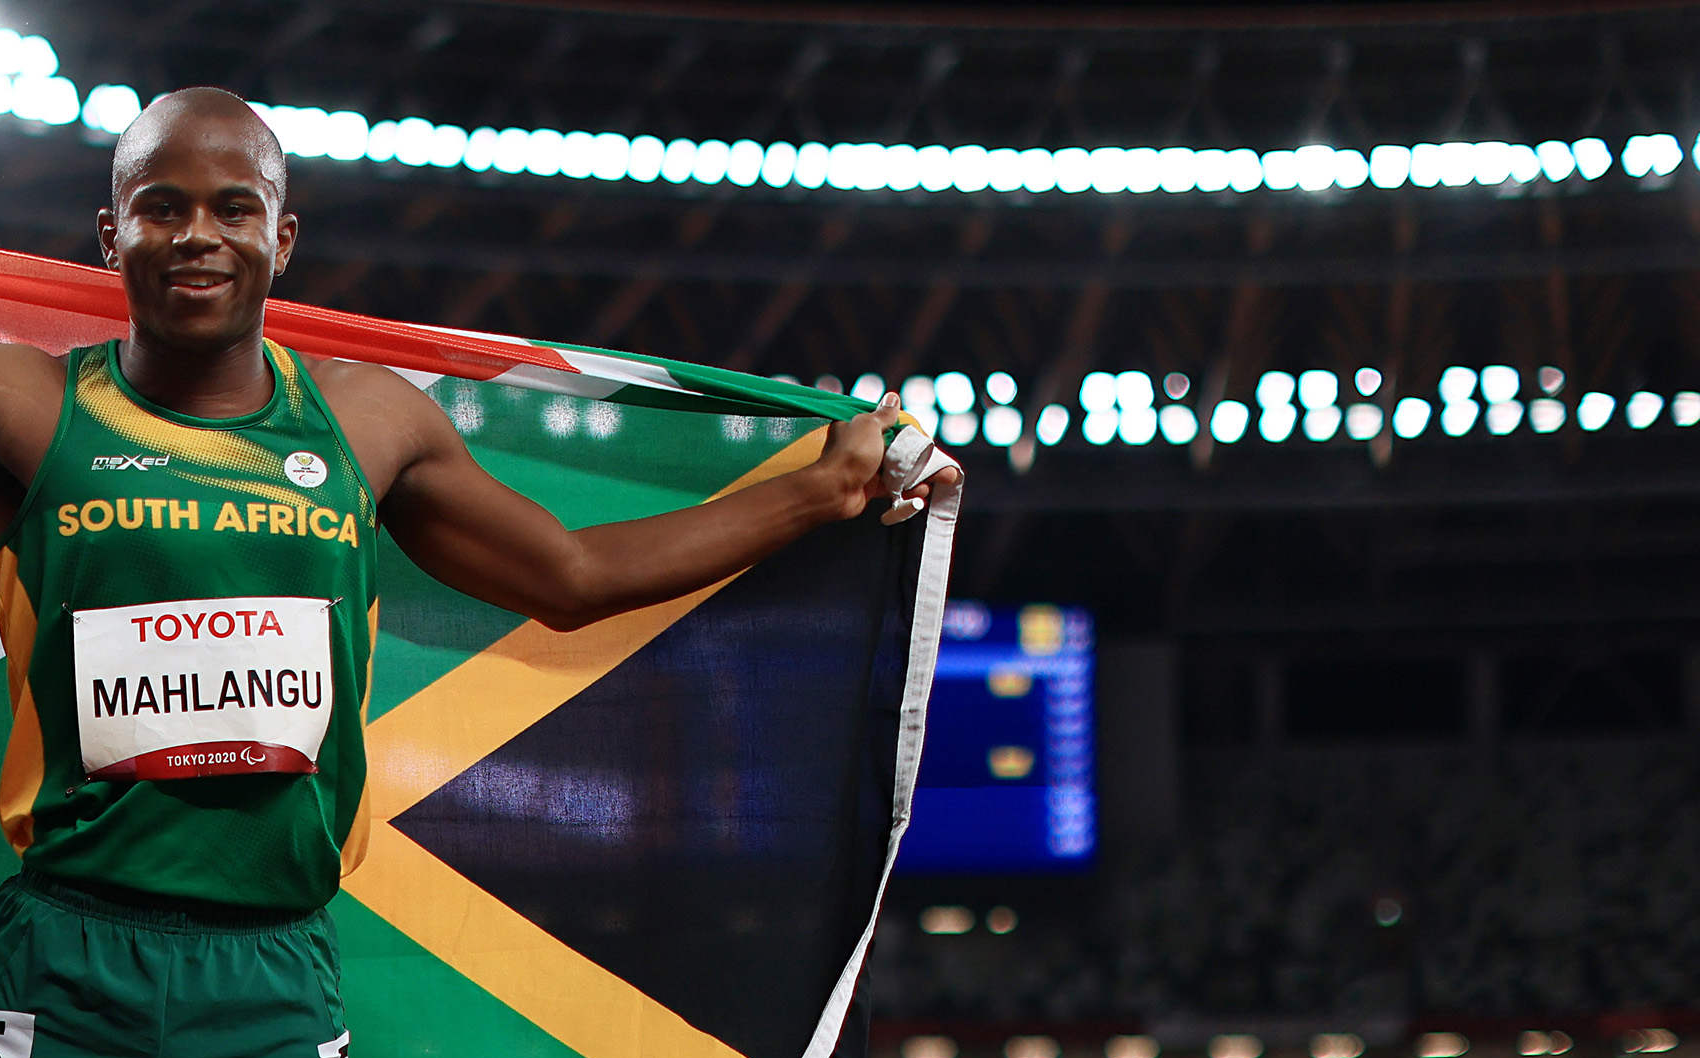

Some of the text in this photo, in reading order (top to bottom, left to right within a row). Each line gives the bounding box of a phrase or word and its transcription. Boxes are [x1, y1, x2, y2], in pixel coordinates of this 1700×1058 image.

[58, 498, 358, 548] SOUTH AFRICA
[131, 611, 284, 642] TOYOTA
[93, 669, 322, 718] MAHLANGU
[167, 752, 237, 767] TOKYO 2020
